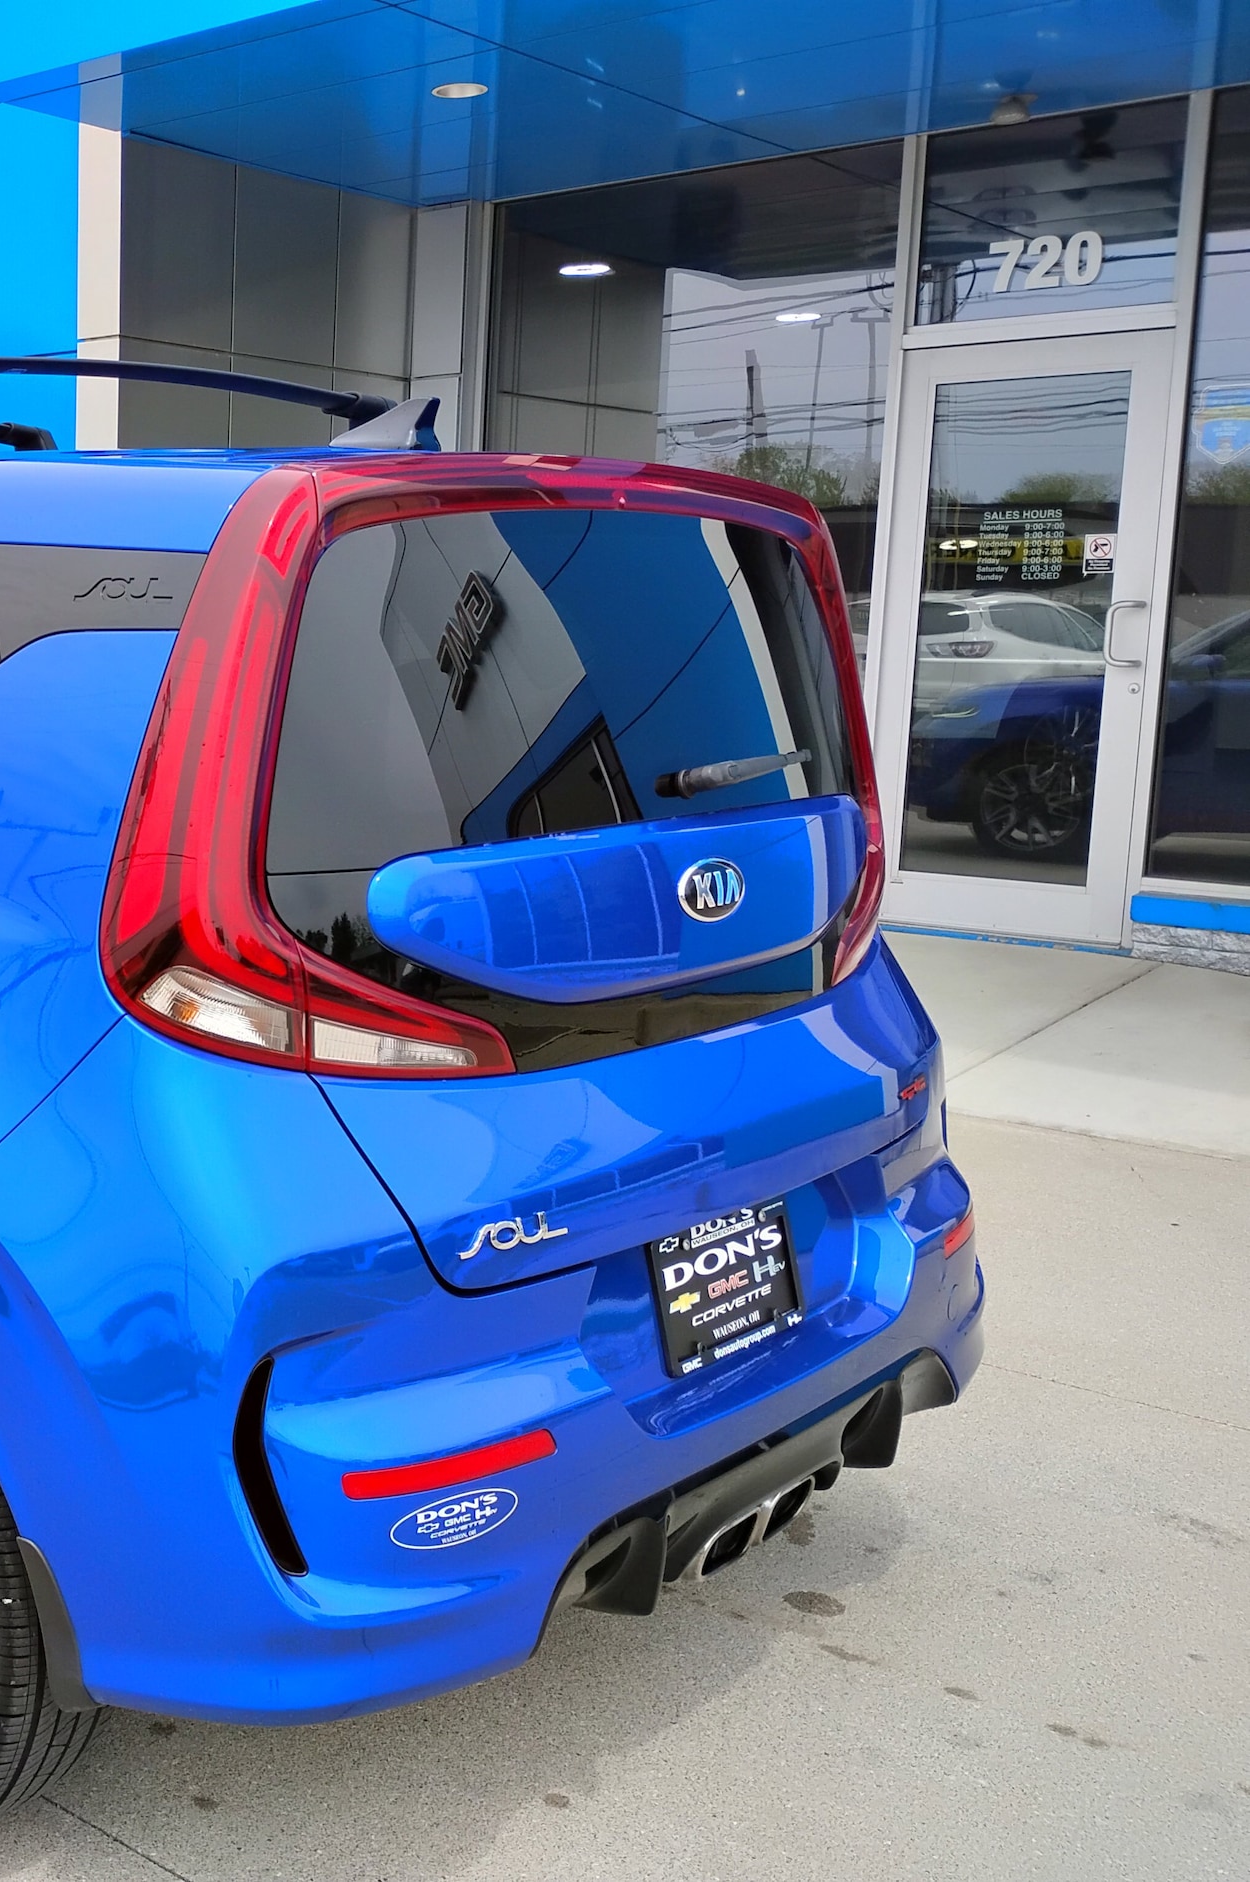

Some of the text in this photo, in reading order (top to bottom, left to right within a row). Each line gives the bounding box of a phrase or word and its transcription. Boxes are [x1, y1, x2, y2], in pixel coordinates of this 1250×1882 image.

[989, 231, 1103, 293] 720
[983, 509, 1063, 521] SALES HOURS
[979, 522, 1065, 532] Monday 9:00-7:00
[978, 540, 1022, 548] Wednesday
[979, 532, 1010, 540] Tuesday
[977, 548, 1012, 556] Thursday
[976, 557, 1000, 565] Friday
[976, 565, 1009, 573] Saturday
[975, 572, 1060, 581] Sunday CLOSED
[692, 868, 740, 910] KIA
[456, 1211, 569, 1260] SOUL
[661, 1224, 783, 1292] DON'S
[707, 1269, 750, 1299] GMC
[691, 1283, 772, 1327] CORVETTE
[713, 1325, 776, 1360] donsautogroup.com
[681, 1357, 703, 1374] GMC
[416, 1492, 498, 1524] DON'S
[429, 1518, 487, 1539] CORVETTE
[444, 1513, 471, 1527] GMC
